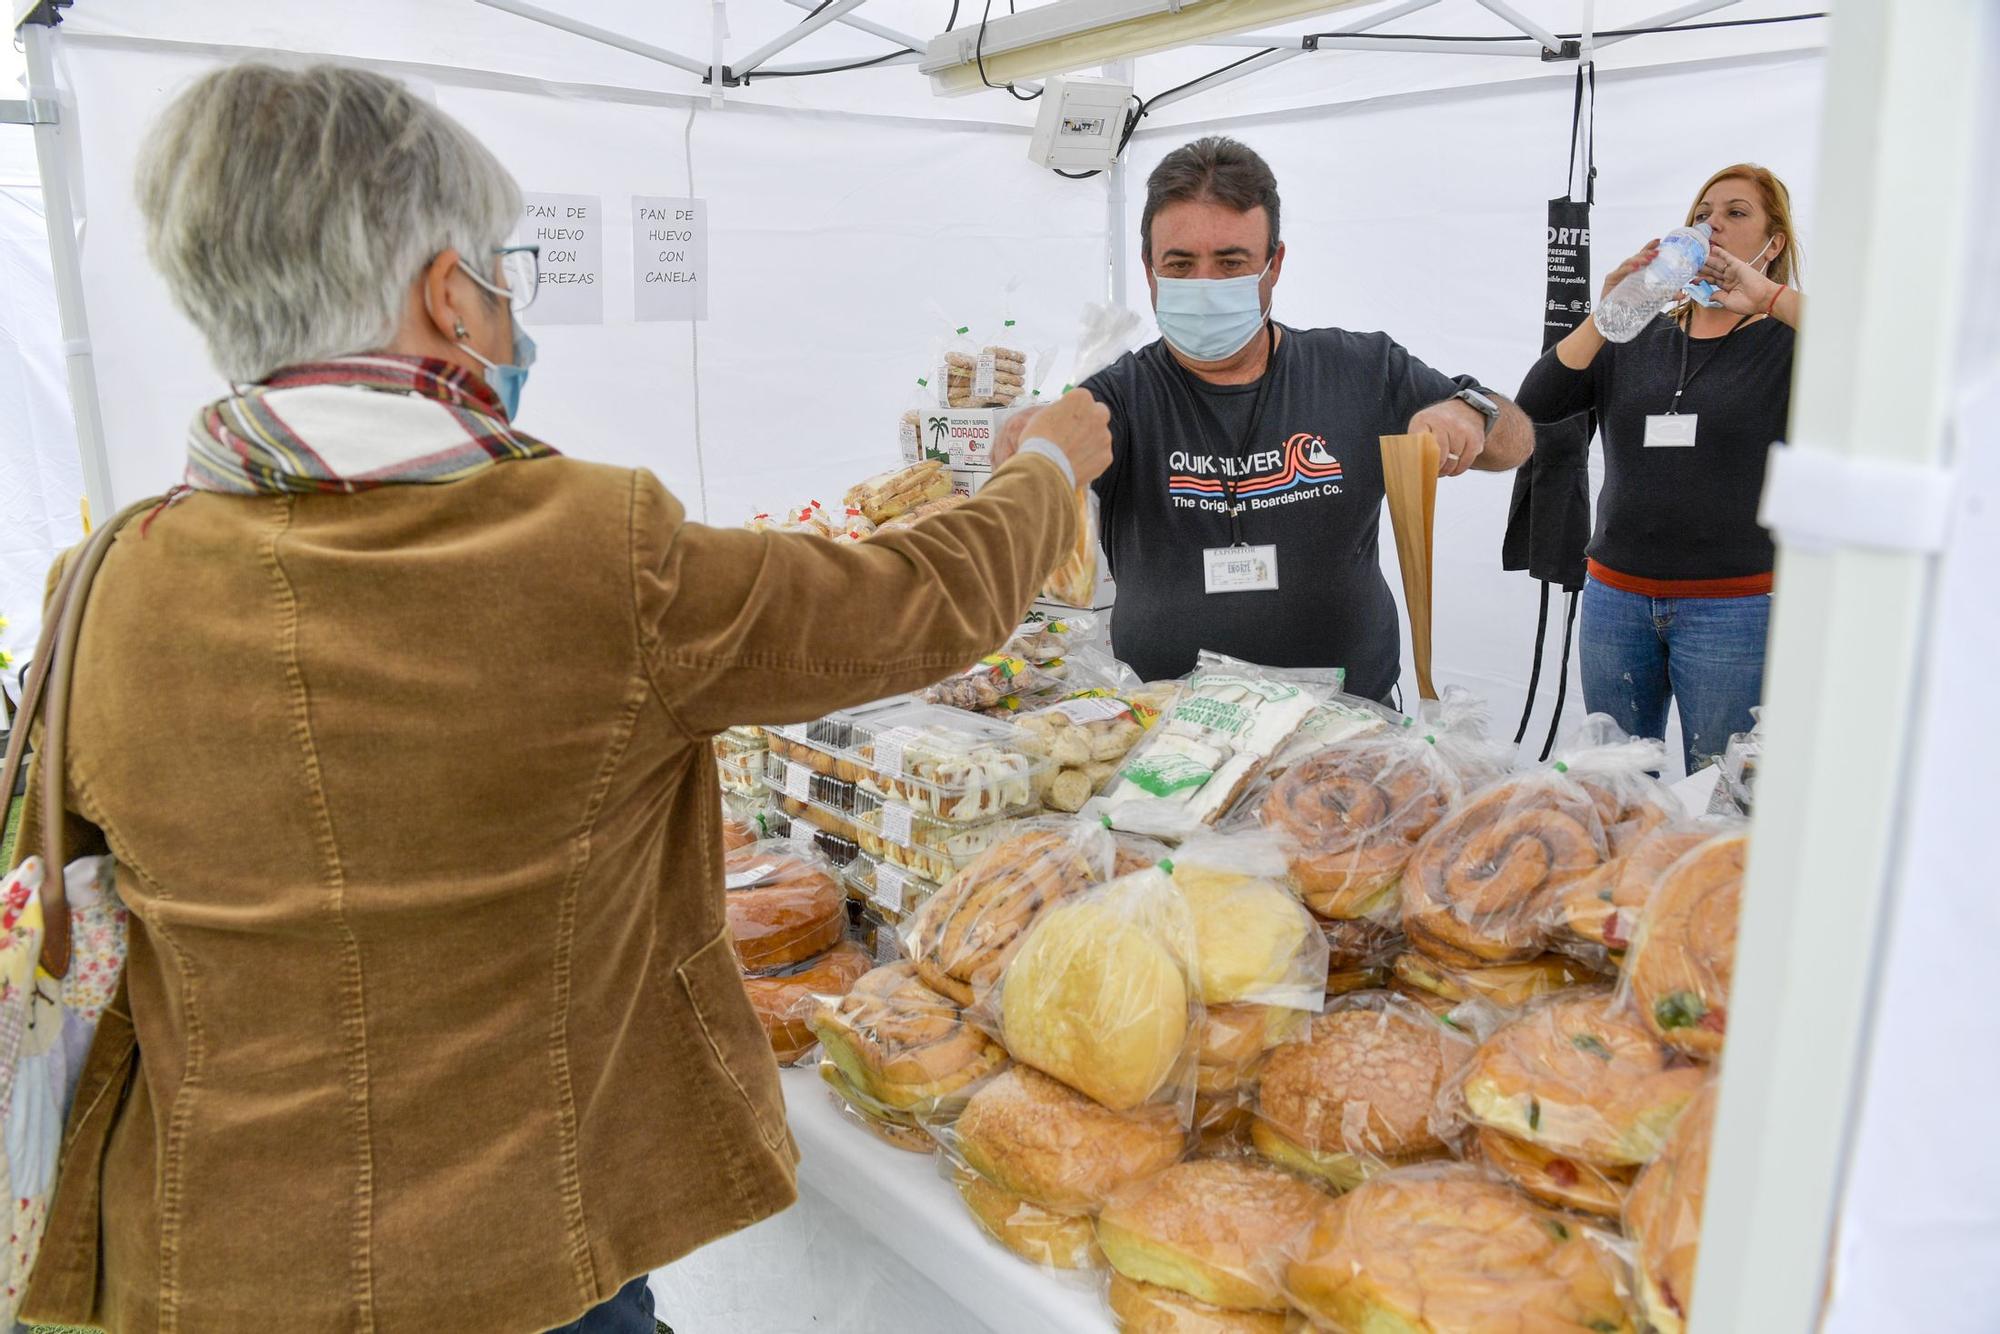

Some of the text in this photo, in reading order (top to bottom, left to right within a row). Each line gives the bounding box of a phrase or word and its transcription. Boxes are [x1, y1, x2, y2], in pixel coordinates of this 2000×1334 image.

[526, 205, 586, 218] PAN DE
[640, 208, 694, 221] PAN DE
[537, 228, 584, 241] HUEVO
[650, 230, 692, 242] HUEVO
[548, 251, 576, 262] CON
[659, 251, 684, 262] CON
[538, 272, 594, 284] EREZAS
[646, 271, 696, 283] CANELA
[951, 427, 990, 439] DORADOS
[1172, 484, 1344, 513] The Origial Boardshort Co.
